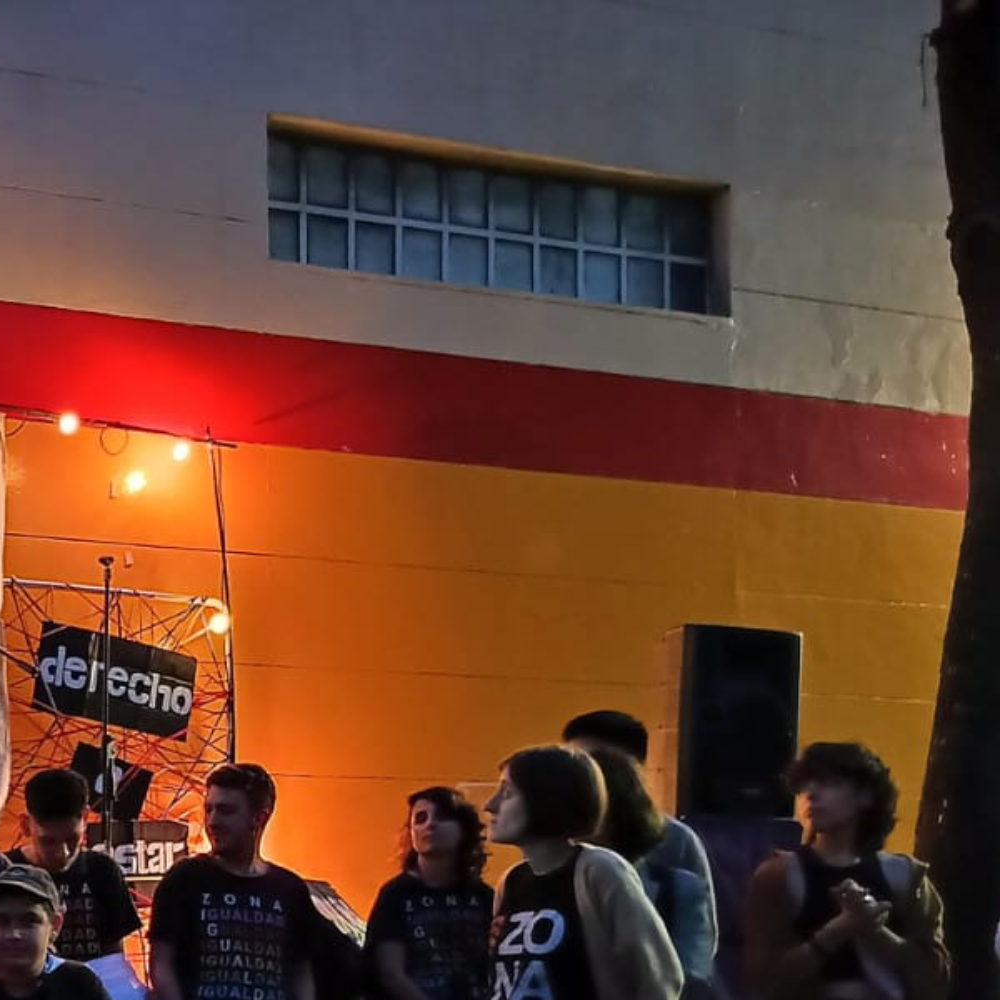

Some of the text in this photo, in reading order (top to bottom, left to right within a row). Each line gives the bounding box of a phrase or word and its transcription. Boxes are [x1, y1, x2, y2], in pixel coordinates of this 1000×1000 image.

[40, 645, 193, 716] derecho
[91, 839, 185, 874] star
[201, 892, 283, 913] ZONA
[498, 908, 567, 956] ZO
